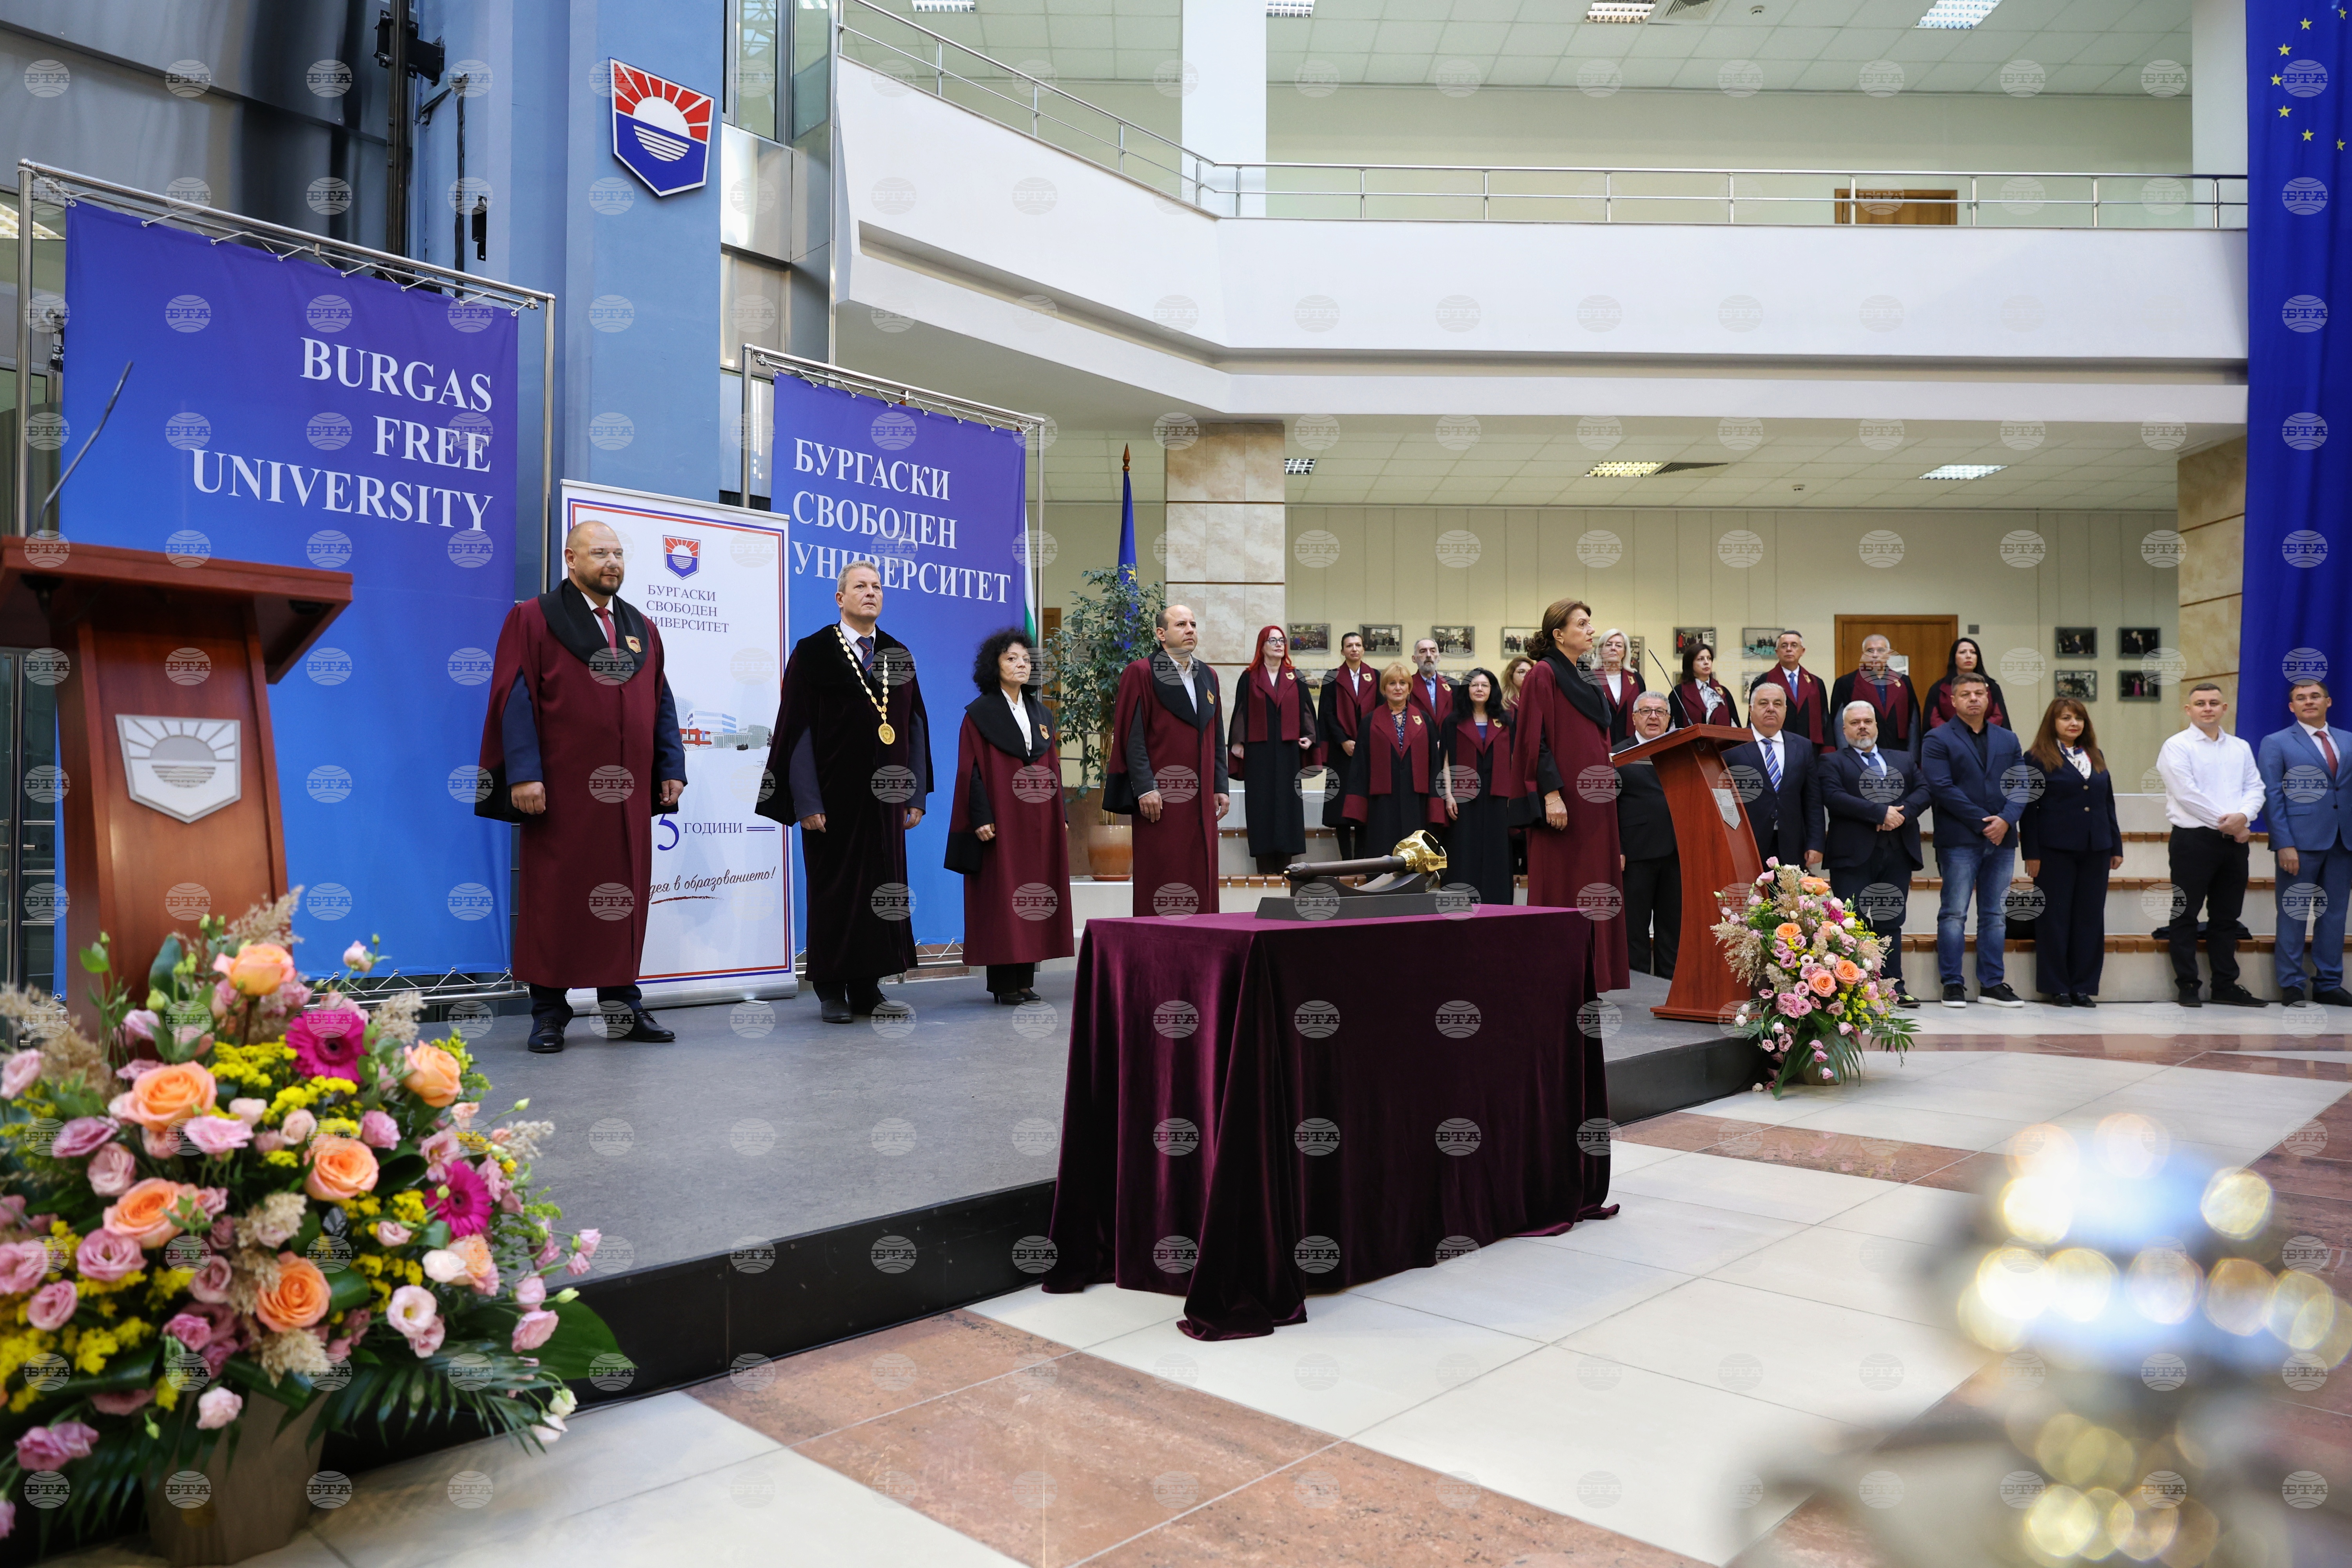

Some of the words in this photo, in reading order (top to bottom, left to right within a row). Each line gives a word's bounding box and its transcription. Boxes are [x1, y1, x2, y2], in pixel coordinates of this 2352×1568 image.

[300, 337, 493, 413] BURGAS
[372, 415, 491, 472] FREE
[189, 448, 493, 532] UNIVERSITY
[793, 437, 950, 501] БУРГАСКИ
[793, 491, 958, 551] СВОБОДЕН
[646, 601, 718, 617] СВОБОДЕН
[647, 584, 716, 601] БУРГАСКИ
[646, 616, 730, 633] ИВЕРСИТЕТ
[684, 822, 743, 836] ГОДИНИ
[649, 883, 670, 901] дея
[673, 875, 681, 891] в
[684, 866, 776, 892] образованието!
